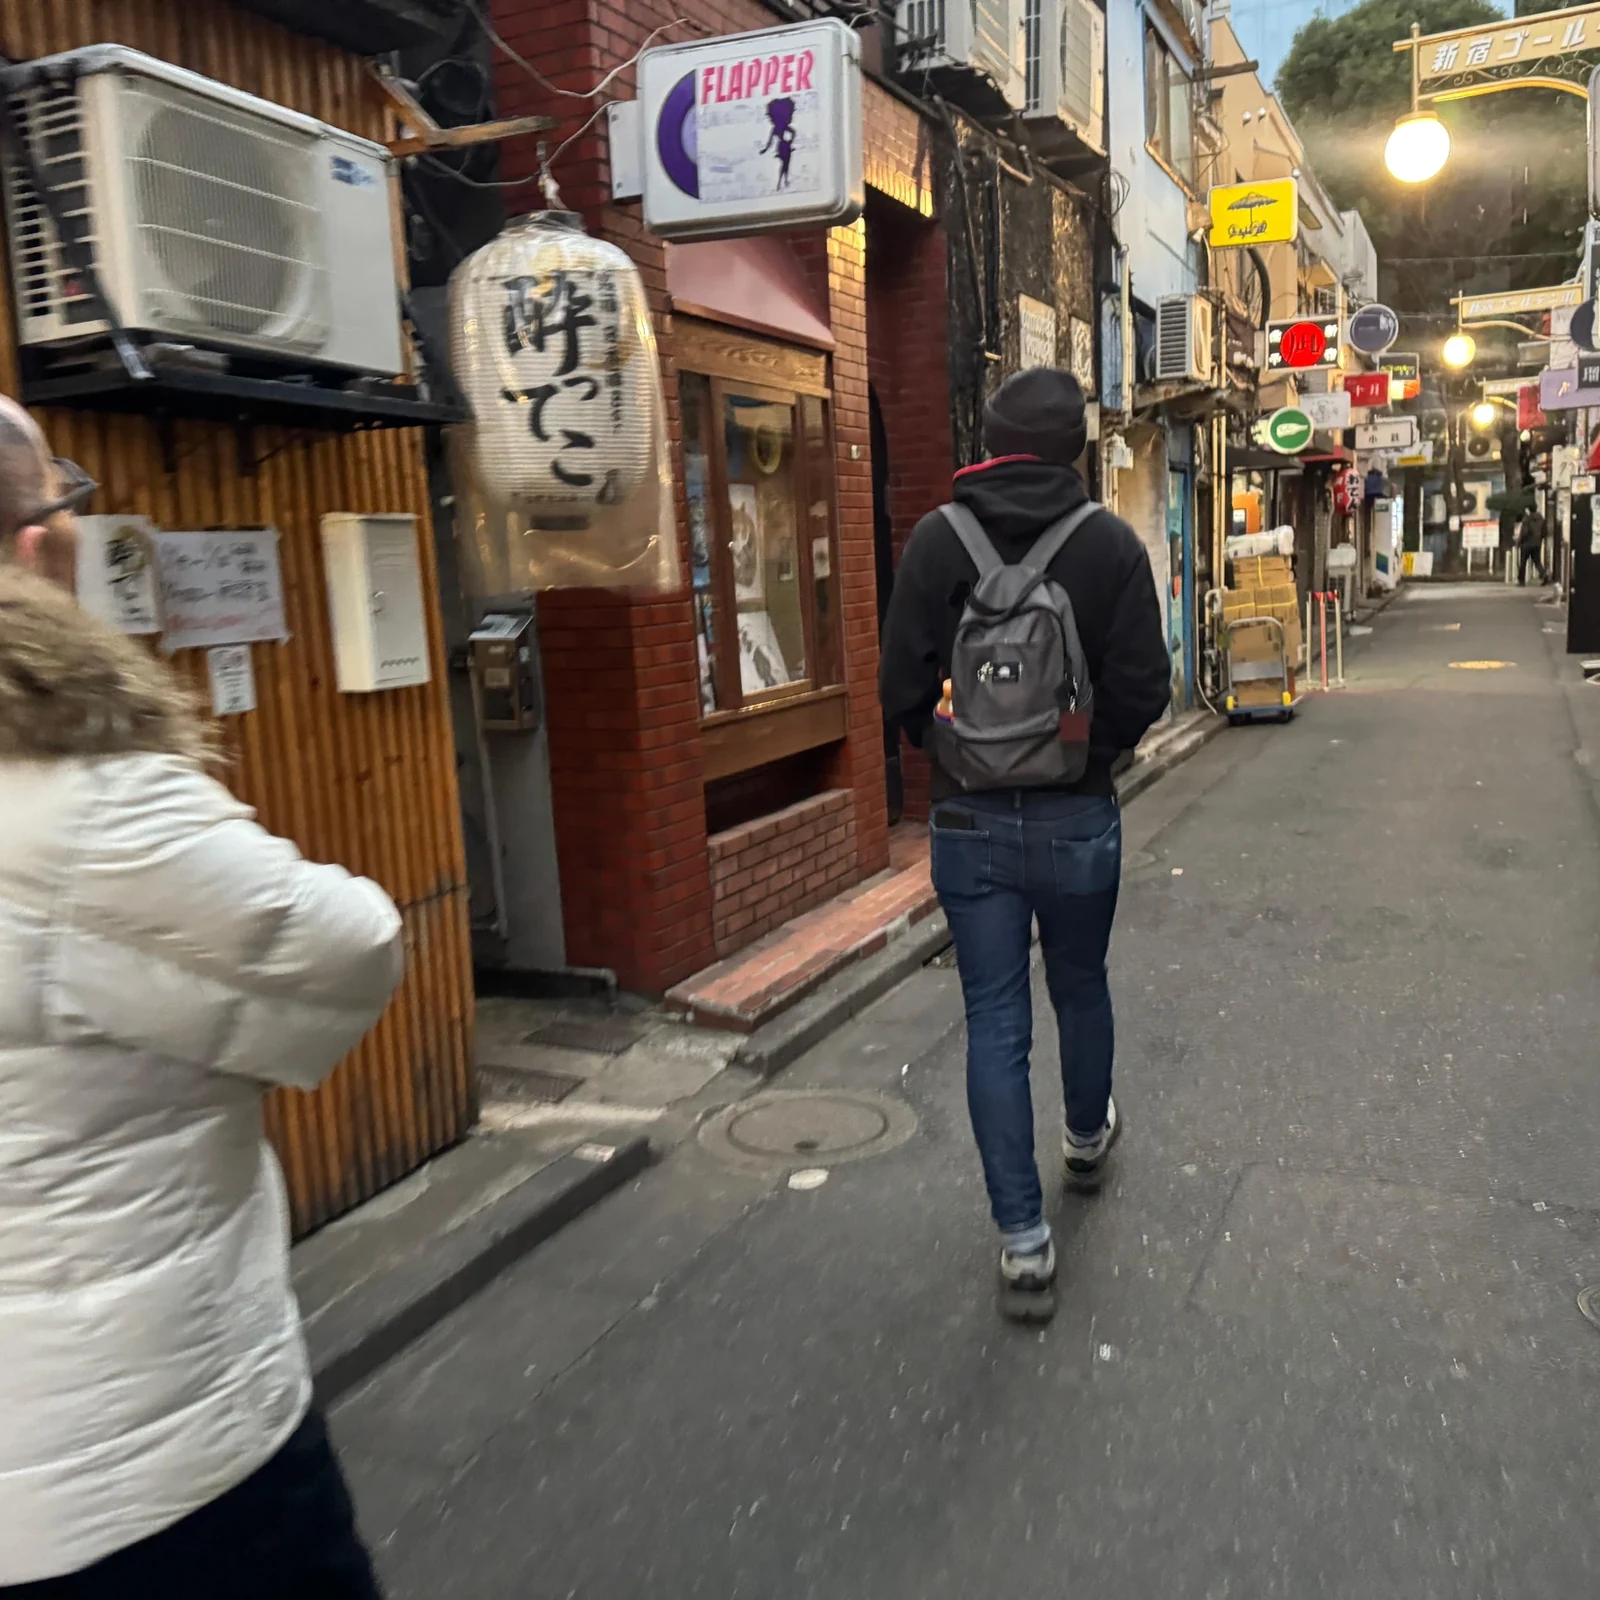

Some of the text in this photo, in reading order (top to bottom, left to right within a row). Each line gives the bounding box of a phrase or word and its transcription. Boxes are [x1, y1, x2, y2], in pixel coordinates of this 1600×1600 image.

[1431, 17, 1600, 73] 新宿ゴール
[701, 50, 815, 105] FLAPPER
